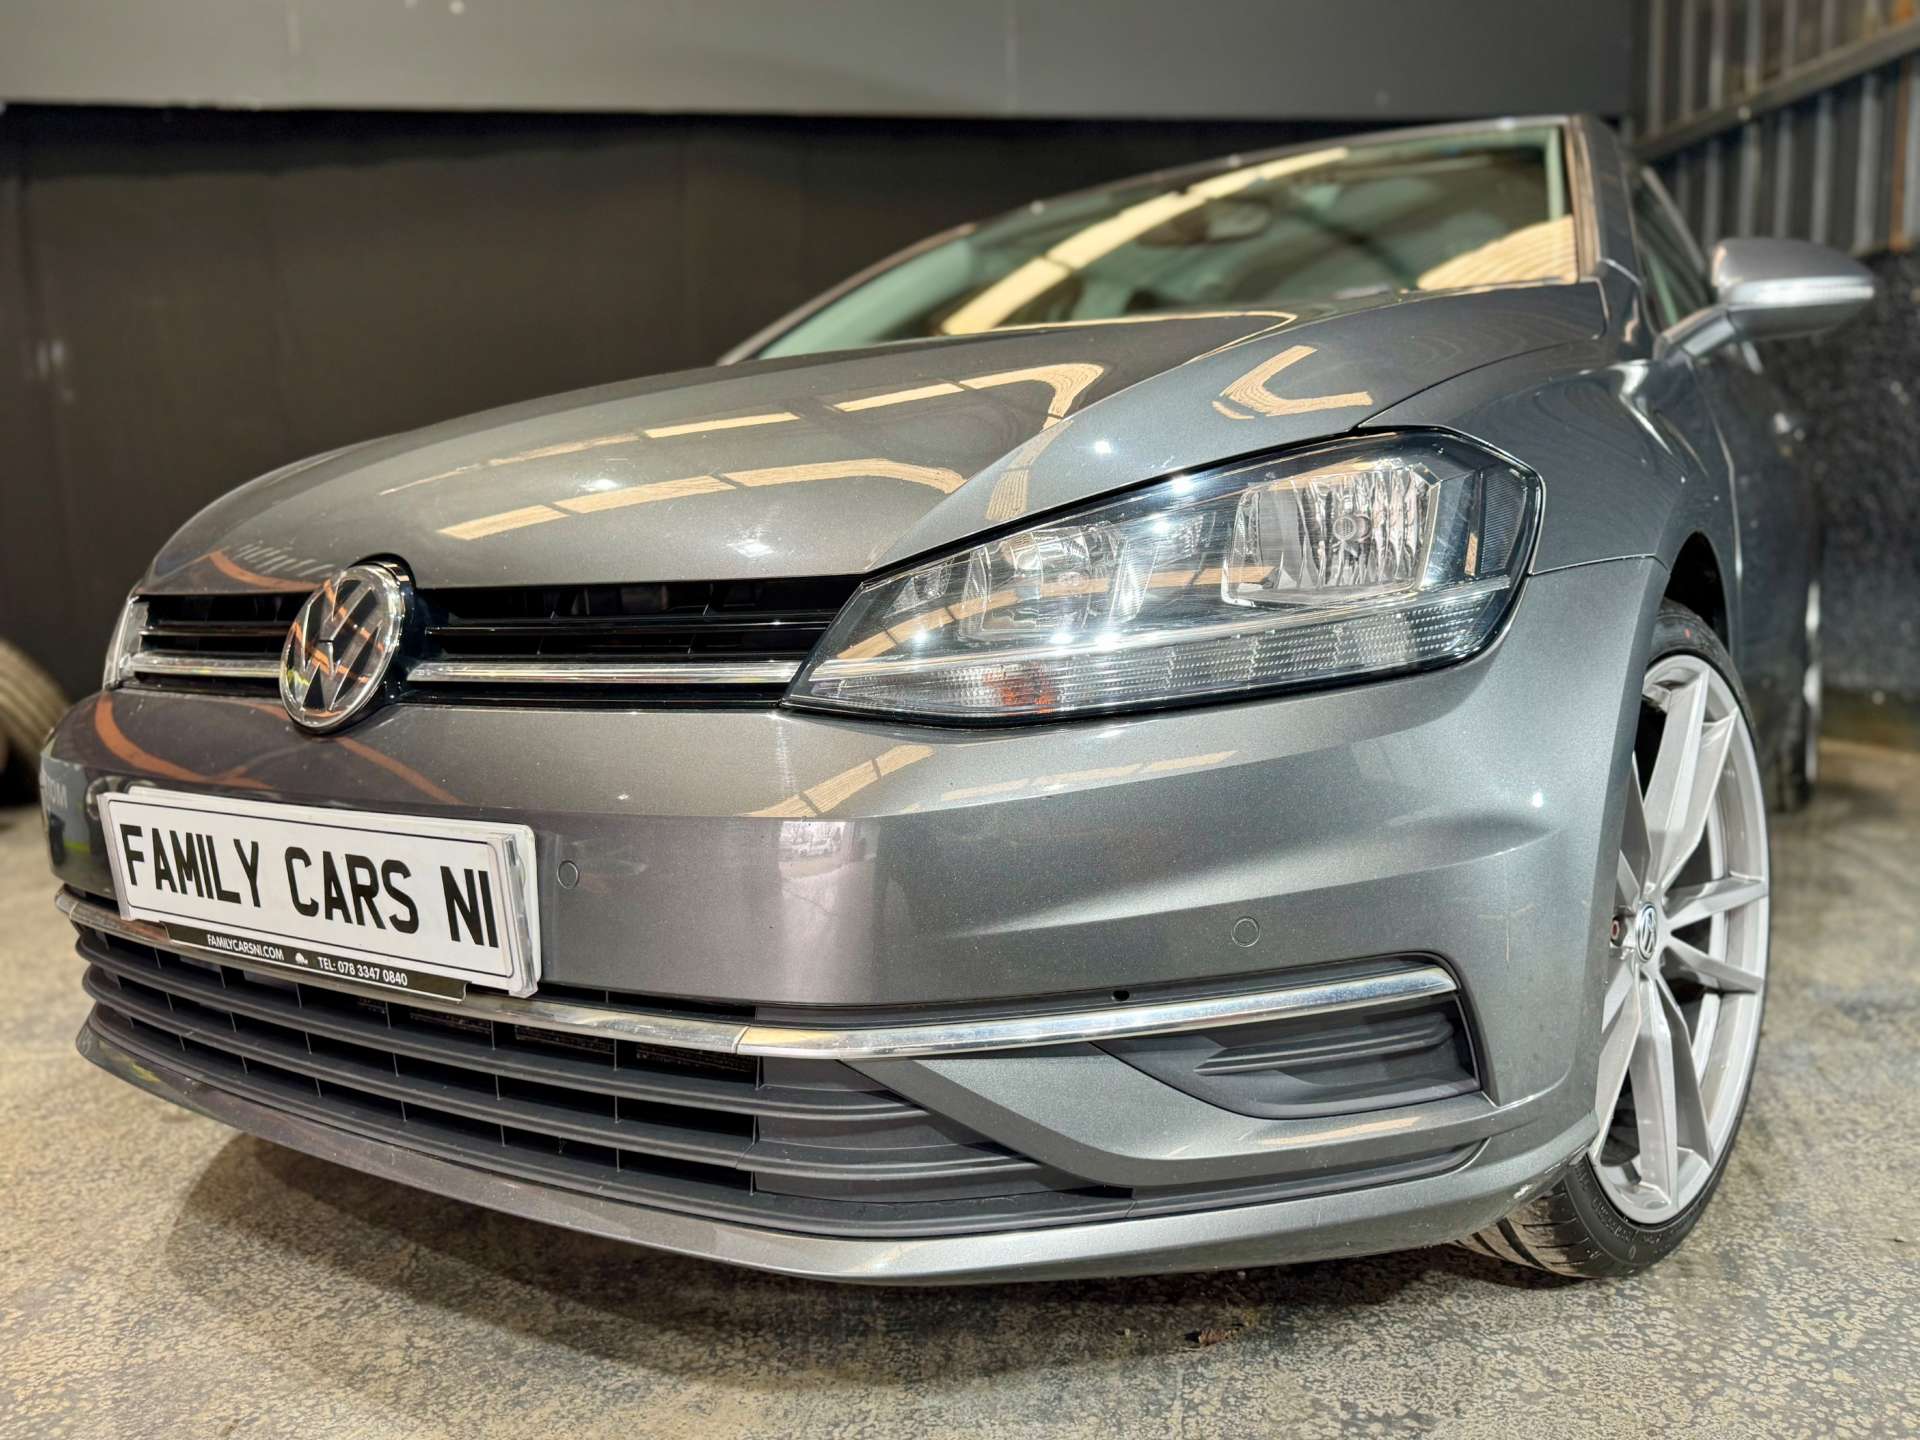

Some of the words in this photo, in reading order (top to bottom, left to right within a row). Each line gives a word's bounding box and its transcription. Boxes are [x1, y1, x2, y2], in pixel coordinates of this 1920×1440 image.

[119, 823, 261, 908] FAMILY
[284, 846, 420, 935] CARS
[440, 865, 499, 949] NI
[206, 934, 284, 961] FAMILYCARSNI.COM
[317, 956, 336, 971] TEL:
[337, 960, 356, 976] 078
[356, 964, 380, 981] 3347
[382, 969, 408, 986] 0840
